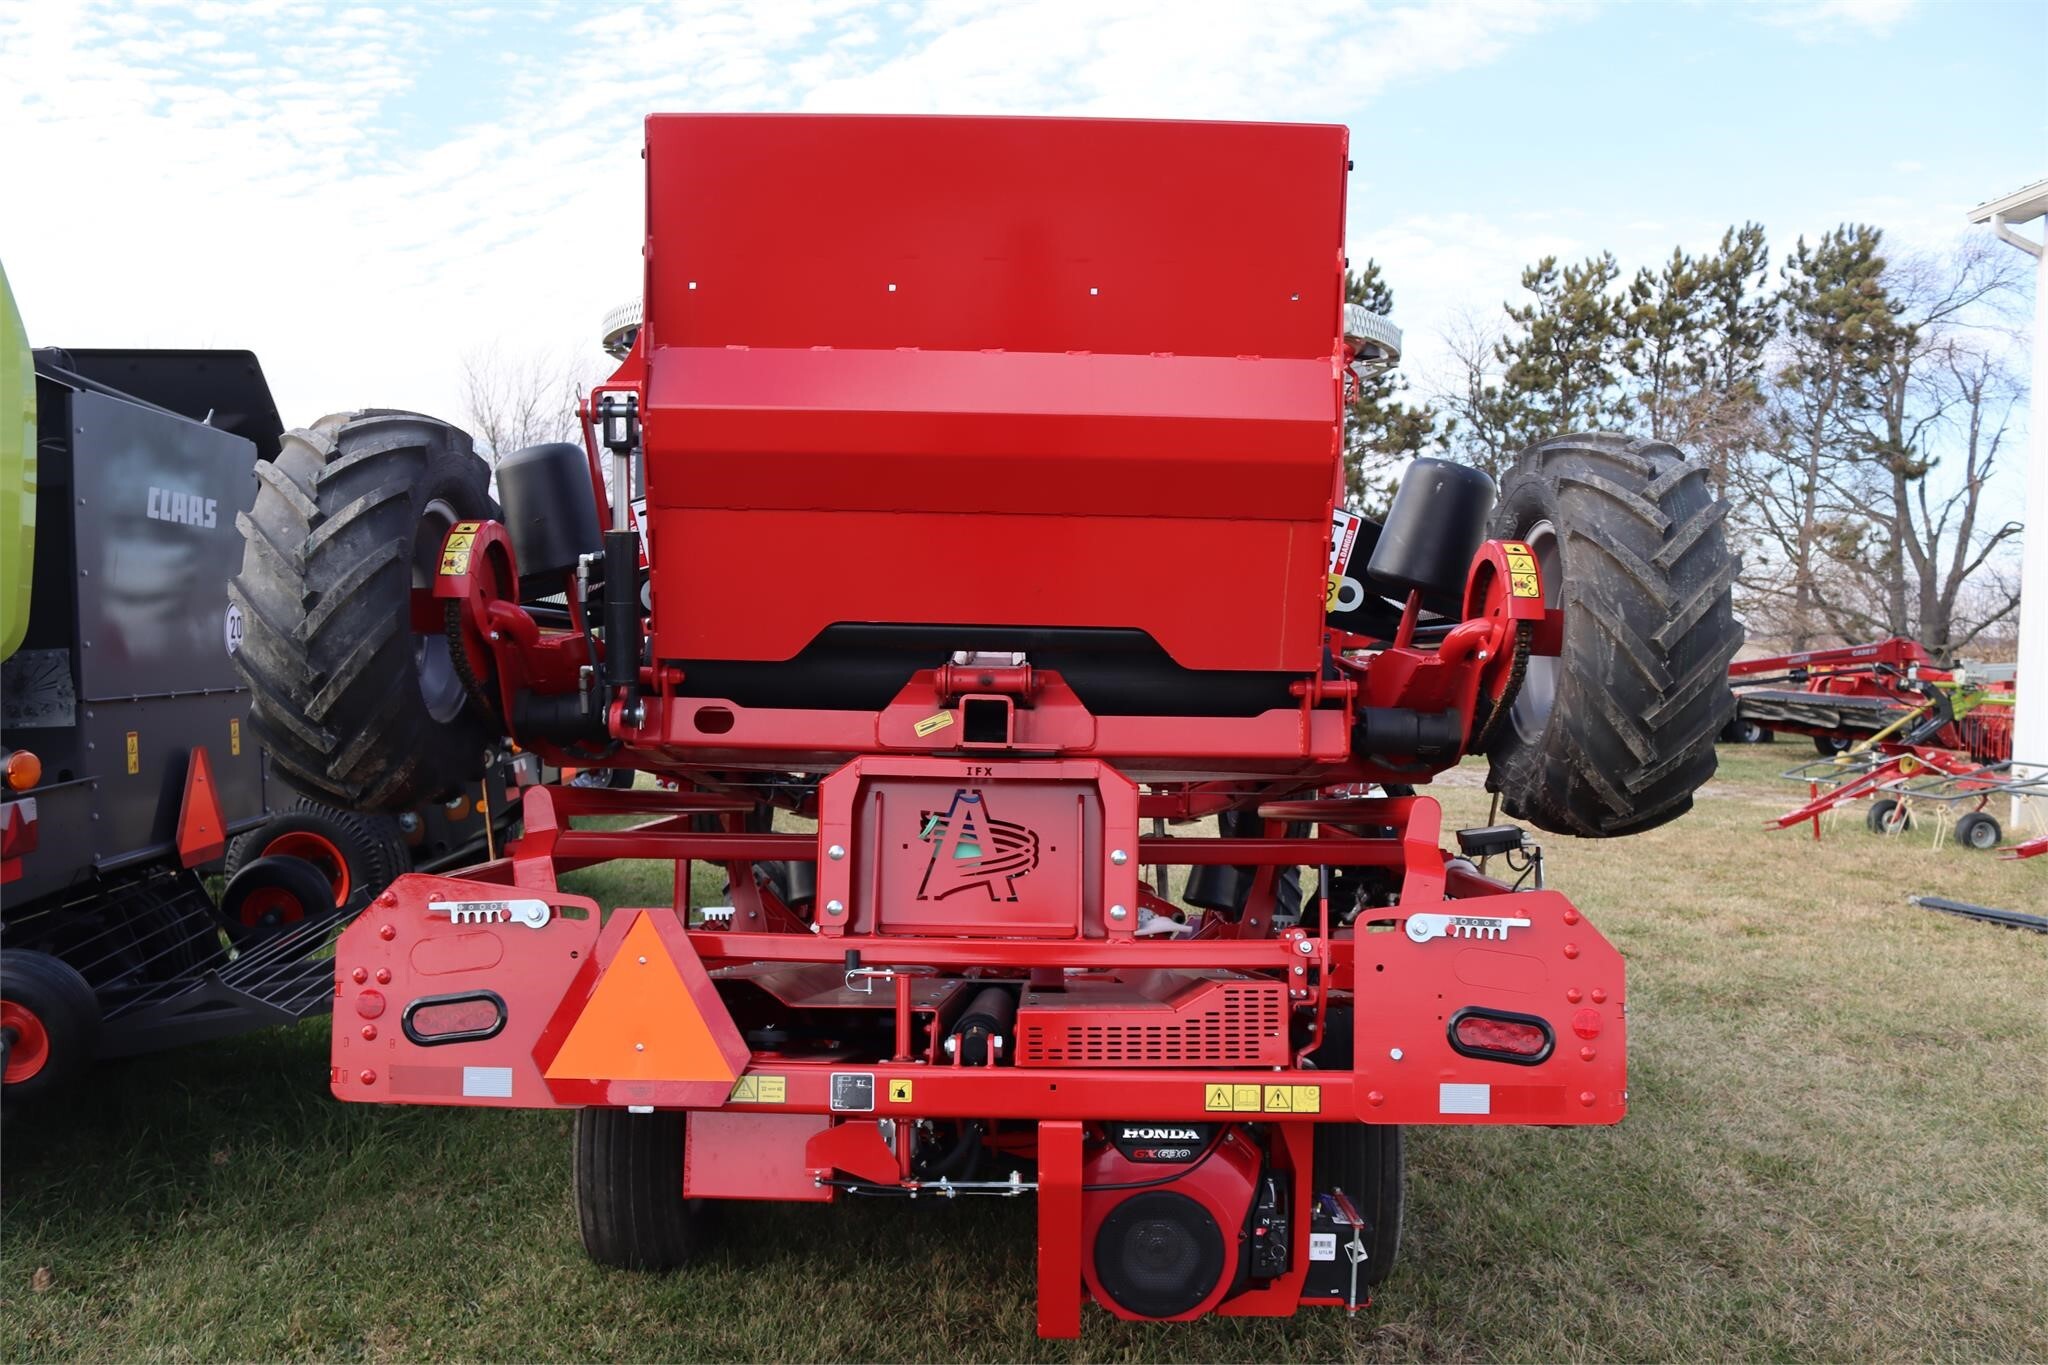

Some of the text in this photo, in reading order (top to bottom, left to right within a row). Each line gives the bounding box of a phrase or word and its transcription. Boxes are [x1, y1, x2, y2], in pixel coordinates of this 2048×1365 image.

[147, 487, 217, 528] CLAAS
[1341, 529, 1355, 558] DANGER
[230, 615, 242, 639] 20
[967, 766, 992, 776] IFX
[1122, 1128, 1200, 1140] HONDA
